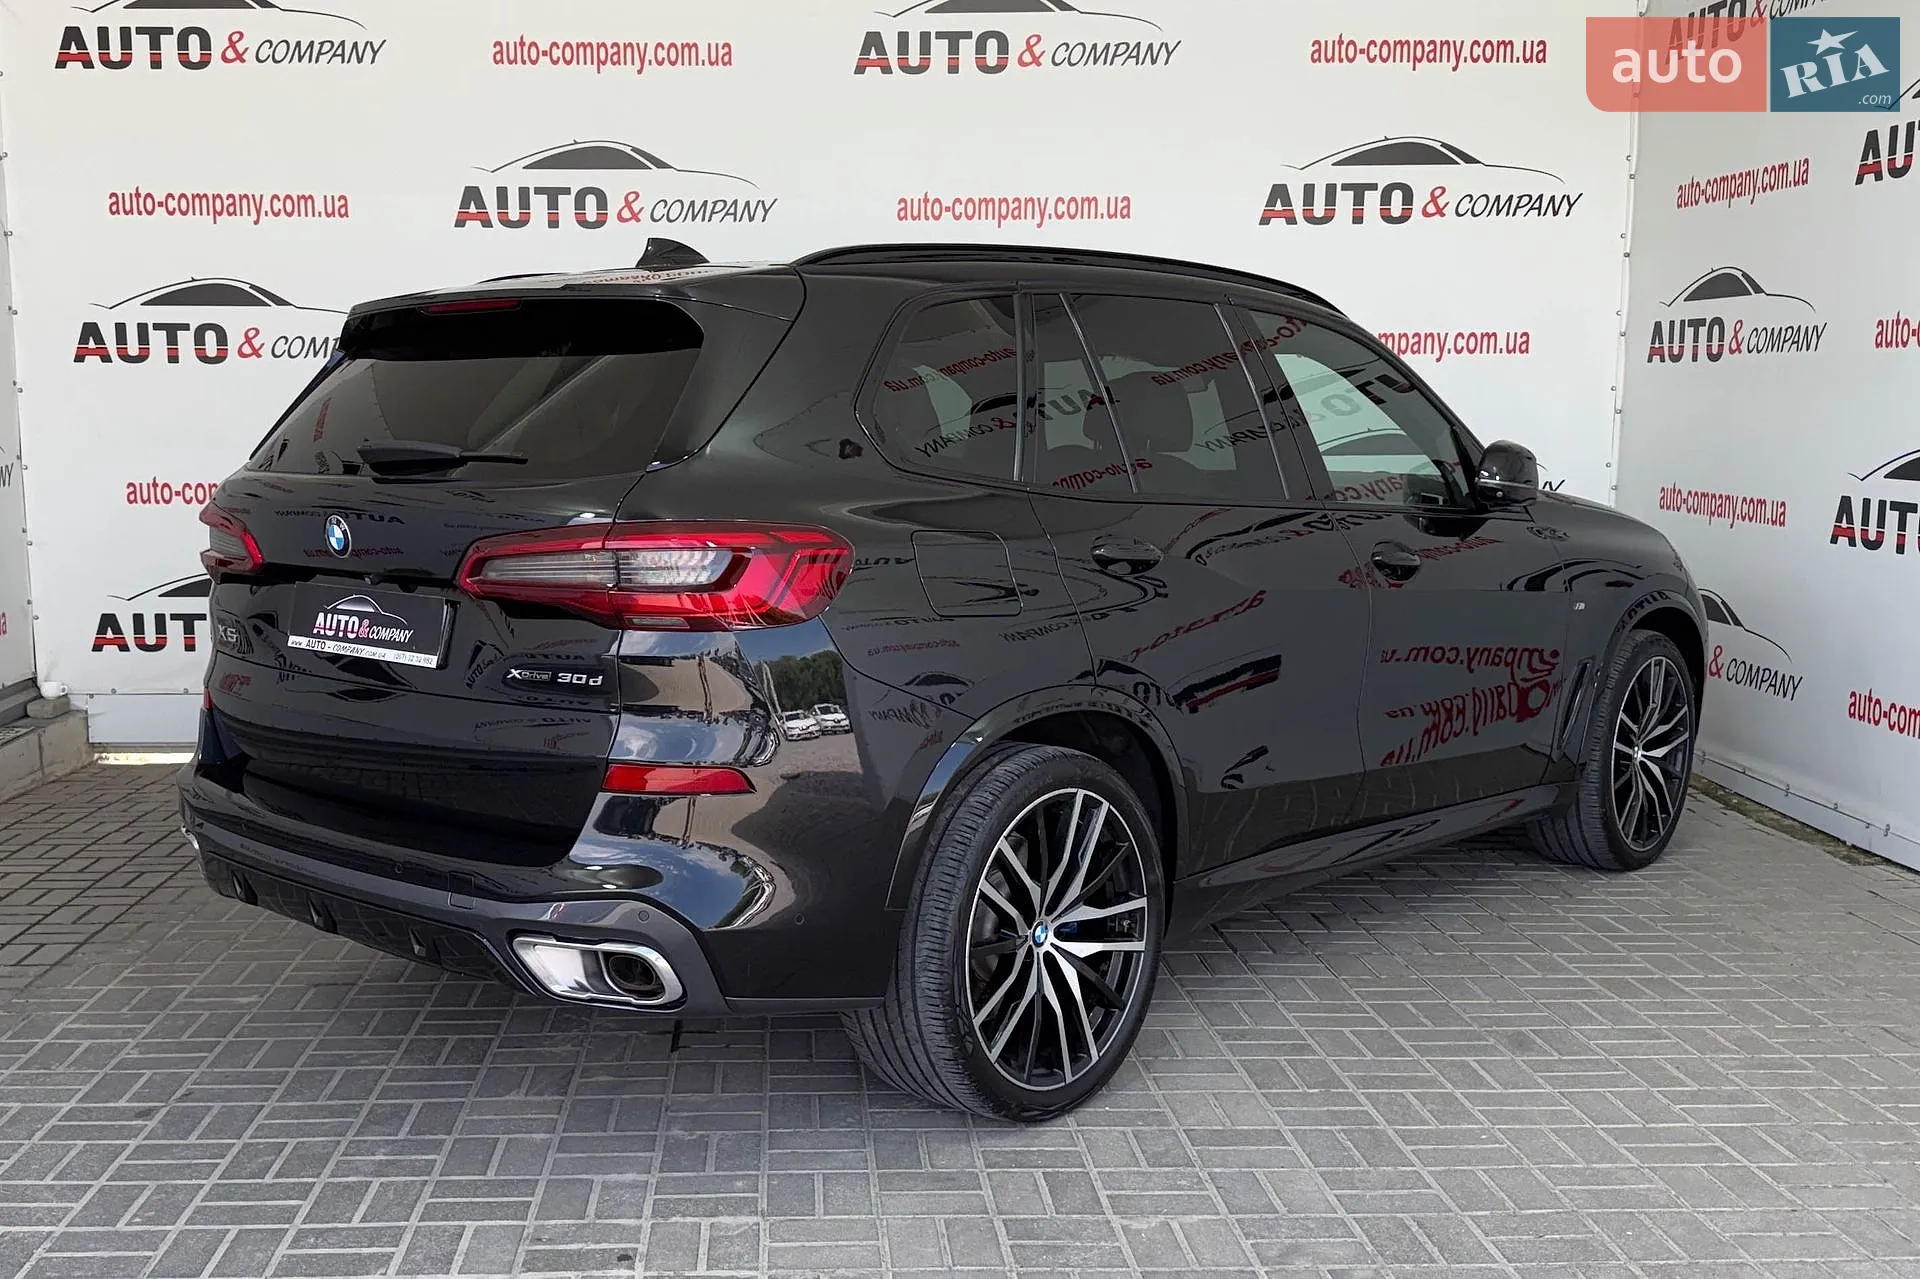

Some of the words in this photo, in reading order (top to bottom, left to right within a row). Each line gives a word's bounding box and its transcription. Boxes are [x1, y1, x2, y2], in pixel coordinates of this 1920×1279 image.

[55, 26, 212, 70] AUTO
[220, 31, 248, 64] &
[255, 39, 387, 65] COMPANY
[492, 34, 732, 73] auto-company.com.ua
[854, 30, 1009, 75] AUTO
[1017, 34, 1044, 68] &
[1051, 40, 1182, 67] COMPANY
[1310, 33, 1548, 72] auto-company.com.ua
[1855, 120, 1920, 185] AU
[1258, 182, 1414, 226] AUTO
[1421, 186, 1447, 219] &
[1454, 192, 1584, 218] COMPANY
[1676, 155, 1809, 209] auto-company.com.ua
[108, 186, 349, 225] auto-company.com.ua
[454, 186, 609, 229] AUTO
[616, 191, 644, 224] &
[650, 198, 778, 224] COMPANY
[897, 192, 1131, 228] auto-company.com.ua
[74, 322, 229, 365] AUTO
[237, 327, 265, 359] &
[1647, 317, 1726, 364] AUTO
[1728, 320, 1744, 355] &
[1746, 322, 1828, 354] COMPANY
[1658, 485, 1787, 529] auto-company.com.ua
[1830, 495, 1920, 555] AUT
[305, 639, 327, 650] AUTO
[313, 612, 360, 639] AUTO
[357, 618, 371, 639] &
[369, 625, 414, 643] COMPANY
[1709, 645, 1724, 679] &
[1727, 658, 1803, 701] COMPANY
